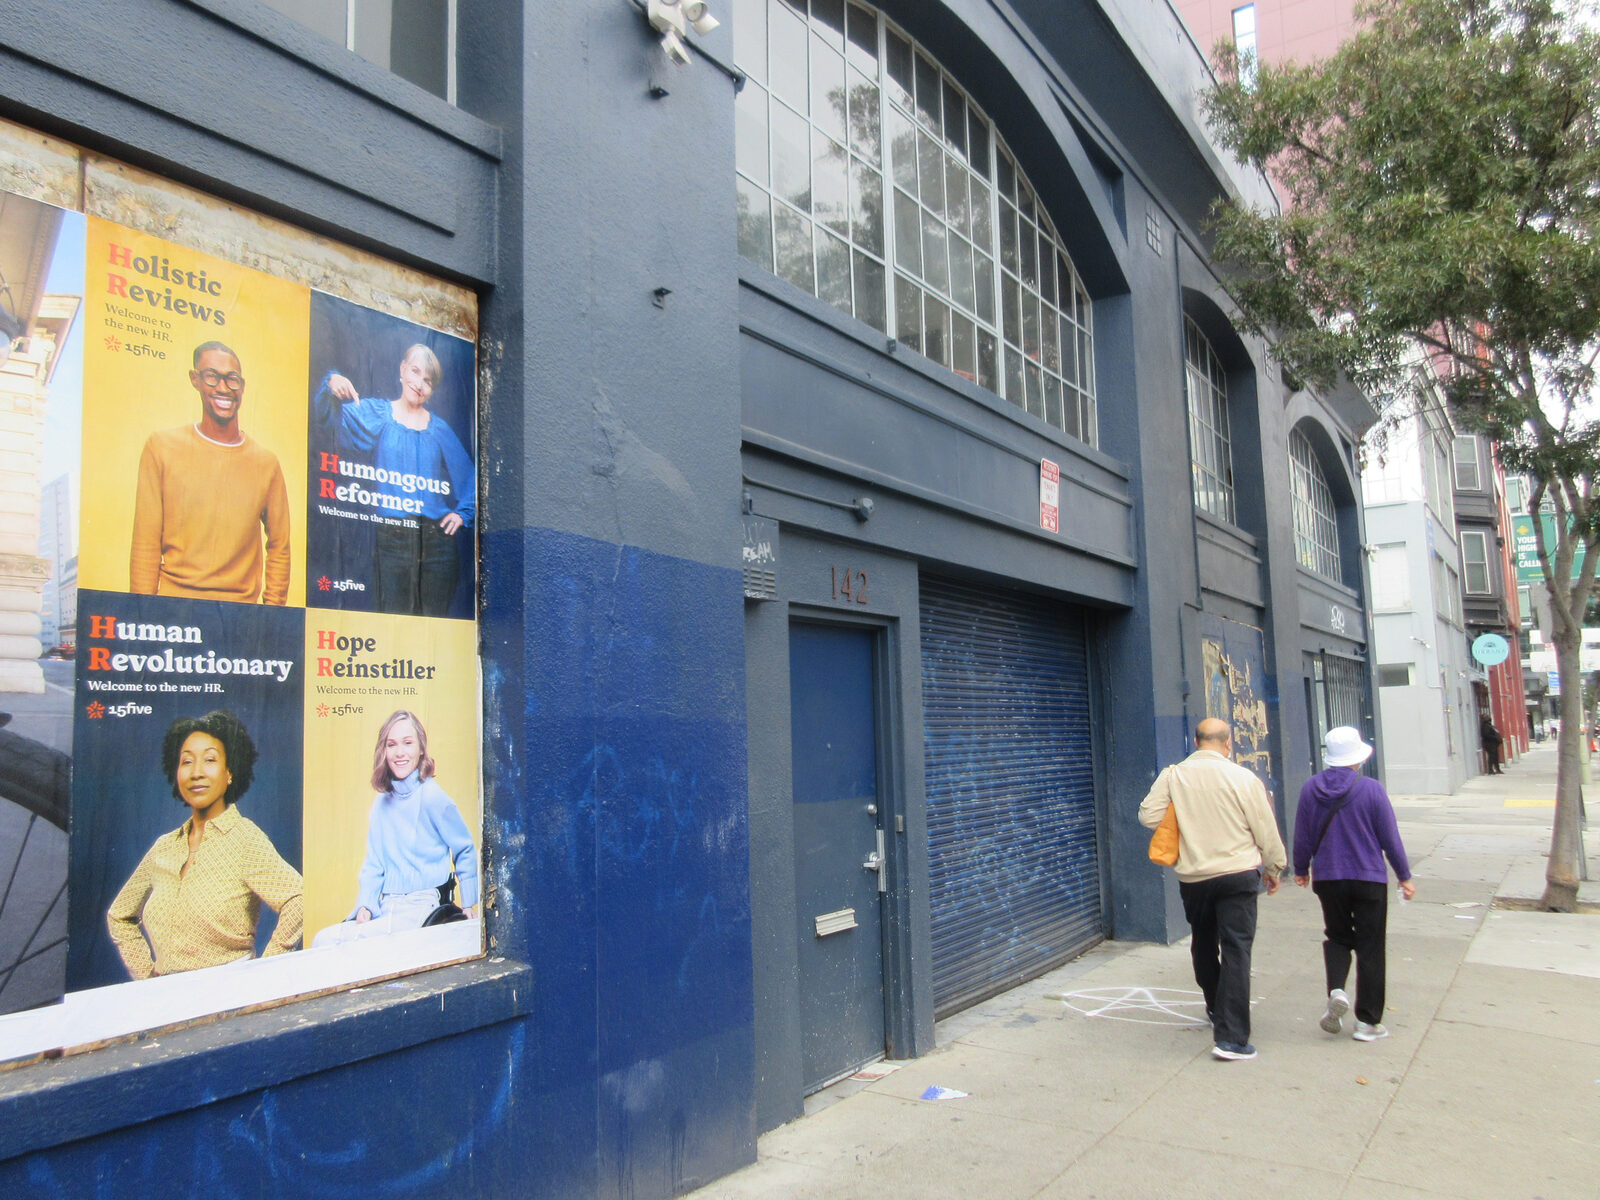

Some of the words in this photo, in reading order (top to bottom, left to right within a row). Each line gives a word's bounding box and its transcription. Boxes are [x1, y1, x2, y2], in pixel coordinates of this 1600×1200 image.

[107, 242, 223, 297] Holistic
[106, 272, 226, 326] Reviews
[104, 302, 158, 326] Welcome
[160, 319, 172, 329] to
[104, 317, 124, 330] the
[126, 324, 149, 337] new
[152, 329, 173, 343] HR.
[125, 343, 166, 360] 15five
[319, 451, 451, 496] Humongous
[319, 478, 425, 514] Reformer
[318, 504, 359, 520] Welcome
[360, 512, 369, 521] to
[370, 513, 384, 524] the
[384, 517, 402, 527] new
[402, 519, 420, 529] HR.
[333, 578, 366, 592] 15five
[831, 565, 868, 604] 142
[89, 615, 203, 644] Human
[316, 630, 377, 657] Hope
[87, 647, 294, 683] Revolutionary
[316, 656, 436, 680] Reinstiller
[87, 680, 143, 693] Welcome
[145, 682, 157, 693] to
[159, 681, 178, 693] the
[180, 684, 202, 694] new
[204, 683, 225, 694] HR.
[316, 685, 357, 695] Welcome
[358, 687, 367, 695] to
[368, 686, 383, 695] the
[384, 688, 401, 696] new
[402, 687, 419, 696] HR.
[108, 701, 153, 717] 15five
[331, 703, 364, 717] 15five
